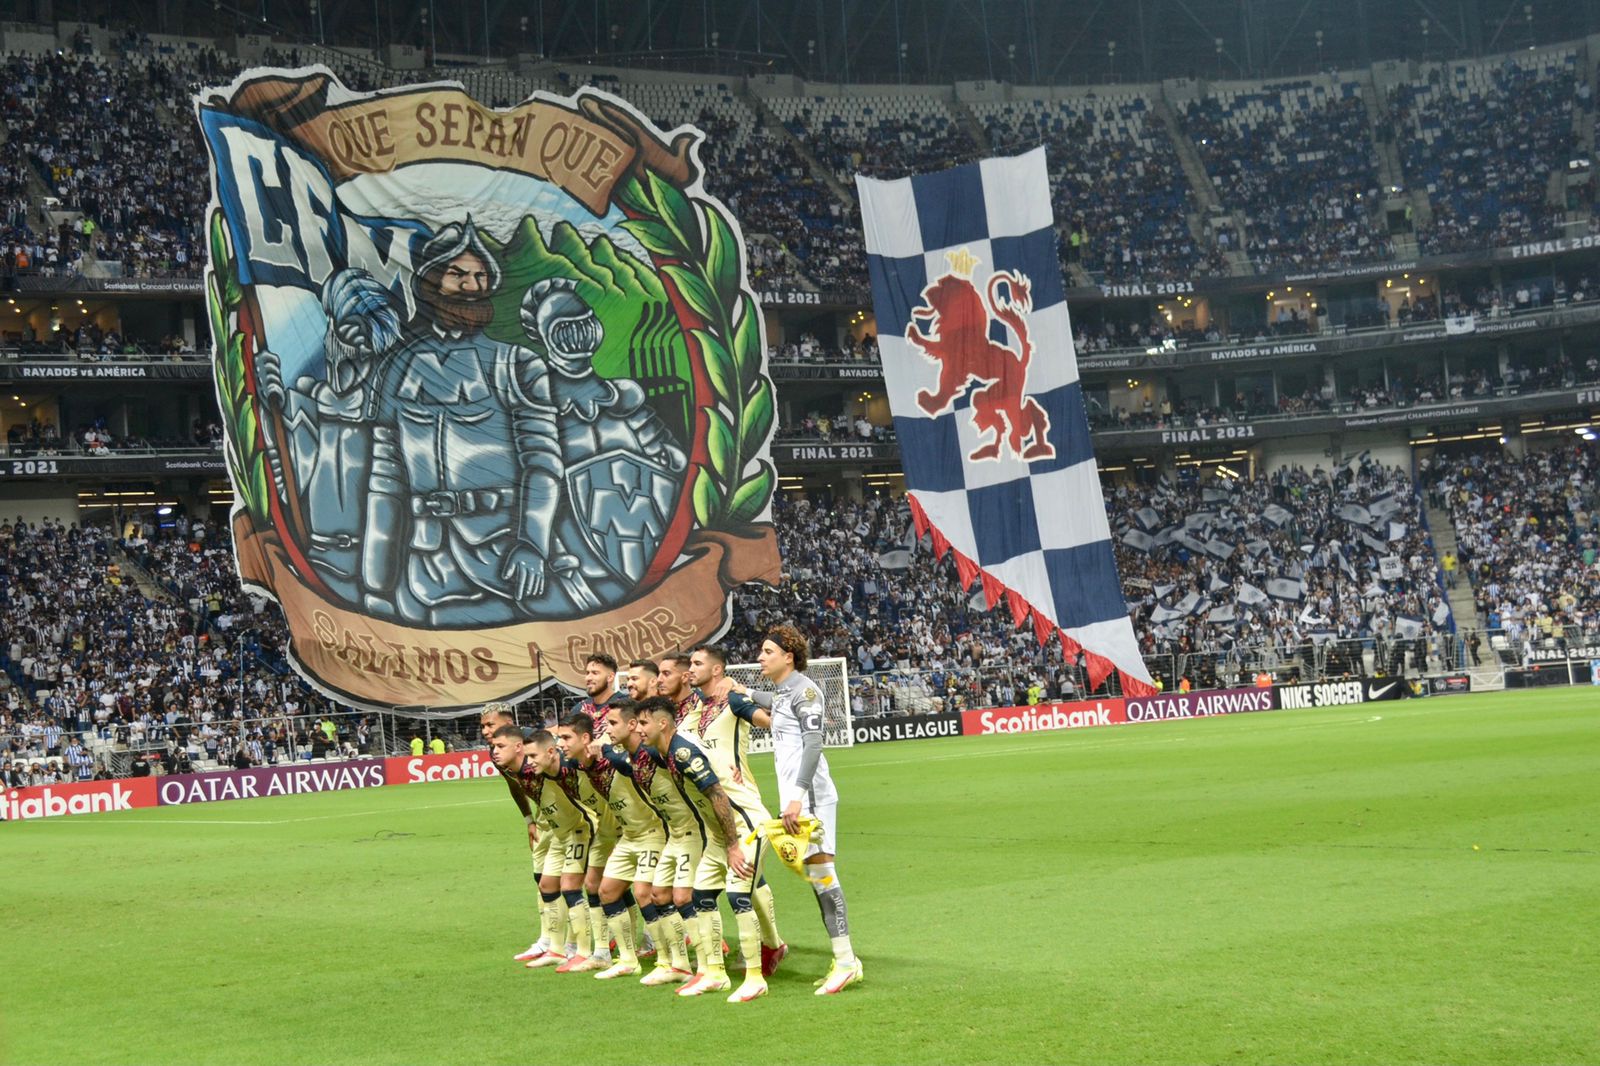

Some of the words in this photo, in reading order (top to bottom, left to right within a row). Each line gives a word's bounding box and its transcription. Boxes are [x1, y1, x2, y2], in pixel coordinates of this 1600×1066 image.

[327, 108, 397, 174] QUE
[415, 101, 536, 159] SEPAN
[540, 121, 624, 191] QUE
[1512, 240, 1566, 258] FINAL
[787, 292, 821, 304] 2021
[1103, 283, 1151, 298] FINAL
[1157, 281, 1195, 294] 2021
[1211, 349, 1257, 361] RAYADOS
[1259, 348, 1271, 356] vs
[1273, 343, 1317, 355] AMÉRICA
[23, 367, 78, 377] RAYADOS
[96, 365, 146, 377] AMÉRICA
[839, 369, 879, 377] RAYADOS
[1451, 406, 1479, 415] LEAGUE
[1162, 430, 1211, 444] FINAL
[1216, 425, 1255, 440] 2021
[792, 448, 836, 459] FINAL
[841, 446, 874, 459] 2021
[13, 461, 58, 474] 2021
[165, 461, 201, 469] Scotiabank
[313, 610, 500, 685] SALIMOS
[1279, 685, 1312, 710] NIKE
[1314, 681, 1363, 706] SOCCER
[1126, 698, 1191, 722] QATAR
[1195, 690, 1272, 716] AIRWAYS
[980, 702, 1111, 735] Scotiabank
[895, 719, 959, 740] LEAGUE
[161, 774, 260, 806] QATAR
[266, 764, 384, 796] AIRWAYS
[566, 843, 584, 859] 20
[639, 851, 659, 868] 26
[679, 854, 689, 871] 2
